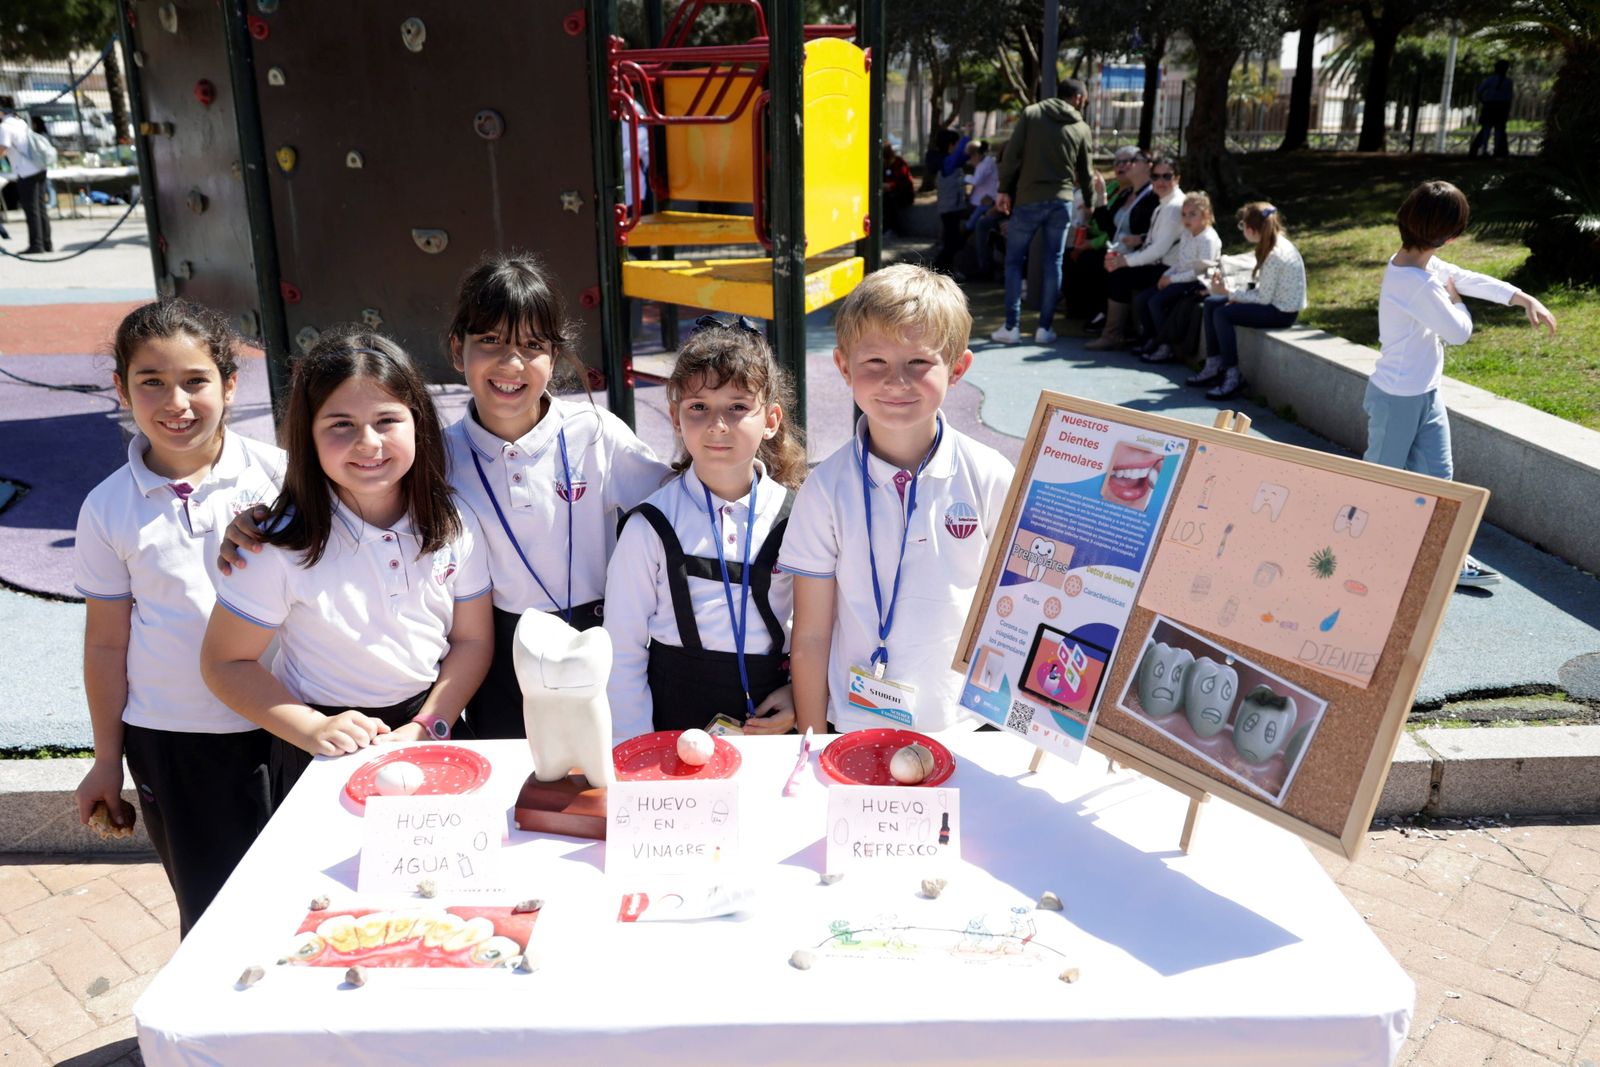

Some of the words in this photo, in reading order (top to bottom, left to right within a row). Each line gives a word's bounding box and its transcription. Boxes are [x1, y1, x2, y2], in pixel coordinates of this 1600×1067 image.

[1061, 414, 1110, 433] Nuestros
[1059, 431, 1100, 450] Dientes
[1043, 445, 1104, 471] Premolares
[1170, 517, 1206, 546] LOS
[1012, 543, 1069, 574] Premolares
[869, 687, 902, 704] STUDENT
[637, 796, 697, 812] HUEVO
[861, 797, 924, 815] HUEVO
[397, 813, 462, 830] HUEVO
[654, 818, 675, 831] EN
[878, 821, 899, 833] EN
[413, 834, 434, 846] EN
[852, 840, 938, 858] REFRESCO
[632, 842, 706, 859] VINAGRE
[391, 855, 449, 875] AGUA
